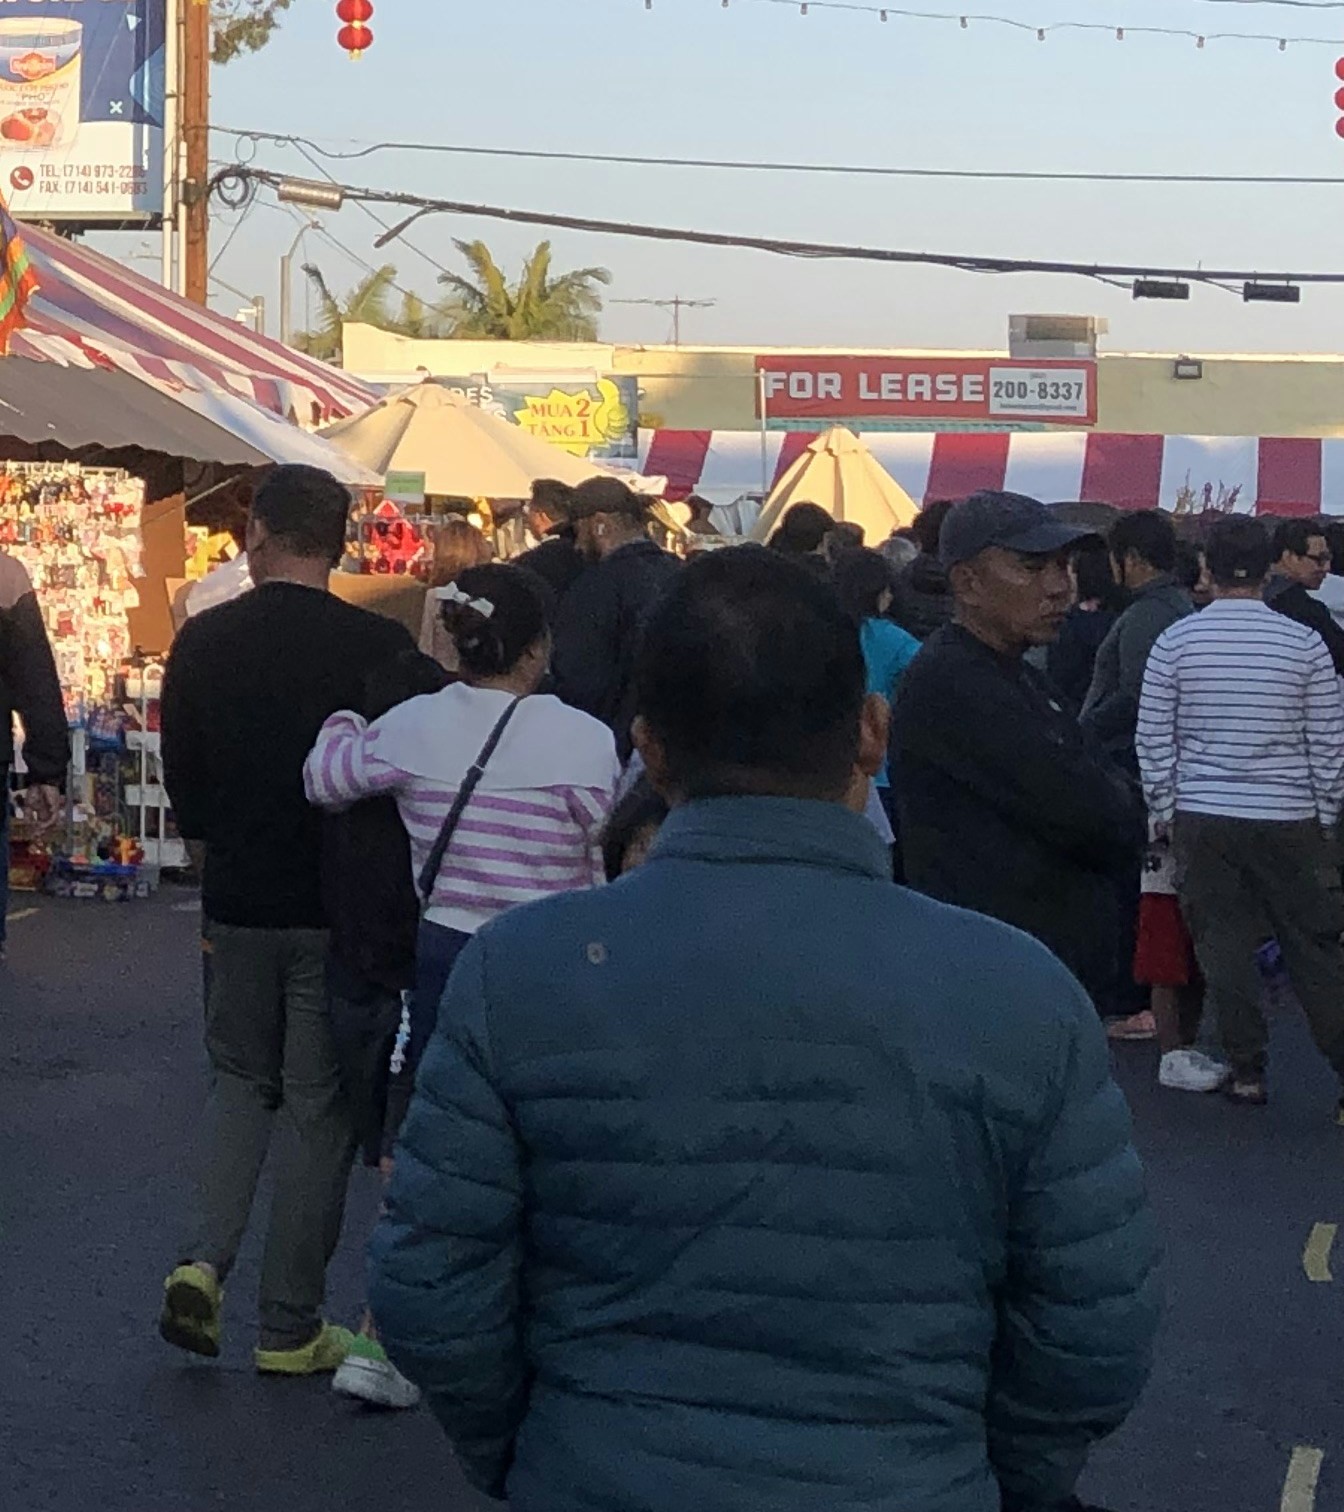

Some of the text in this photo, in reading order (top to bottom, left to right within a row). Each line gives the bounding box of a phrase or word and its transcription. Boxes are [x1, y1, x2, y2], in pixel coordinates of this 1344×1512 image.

[63, 164, 92, 178] (714)
[65, 180, 93, 194] (714)
[765, 372, 985, 402] FOR LEASE
[992, 381, 1083, 401] 200-8337
[530, 398, 591, 418] MUA 2
[579, 419, 590, 437] 1
